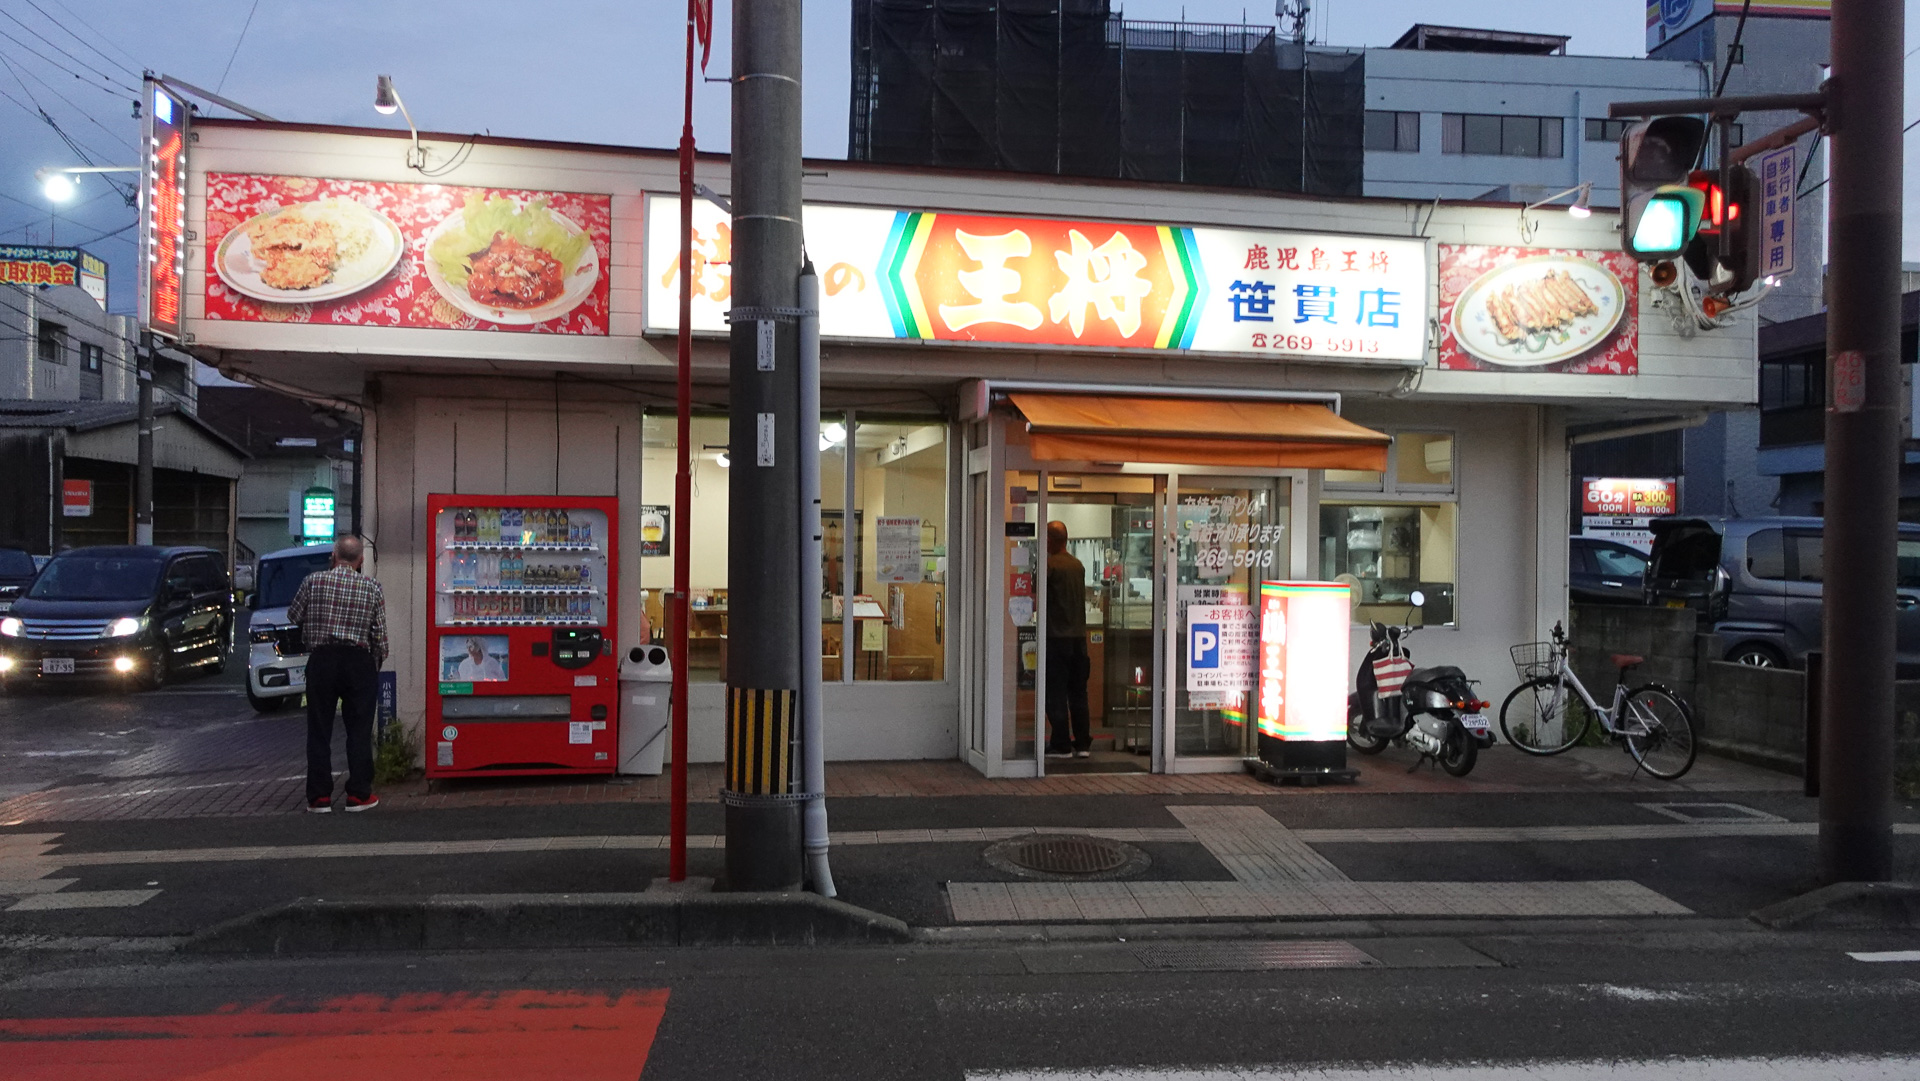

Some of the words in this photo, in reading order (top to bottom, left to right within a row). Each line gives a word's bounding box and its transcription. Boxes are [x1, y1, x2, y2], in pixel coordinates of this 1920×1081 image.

[1766, 162, 1778, 217] 自転車
[1779, 159, 1791, 214] 歩行者
[1243, 243, 1389, 274] 鹿児島王将
[1769, 219, 1785, 270] 専用
[1228, 280, 1402, 329] 笹貫店
[1272, 333, 1380, 354] 269-5913
[1587, 490, 1625, 503] 60分
[1195, 549, 1273, 568] 269-5913
